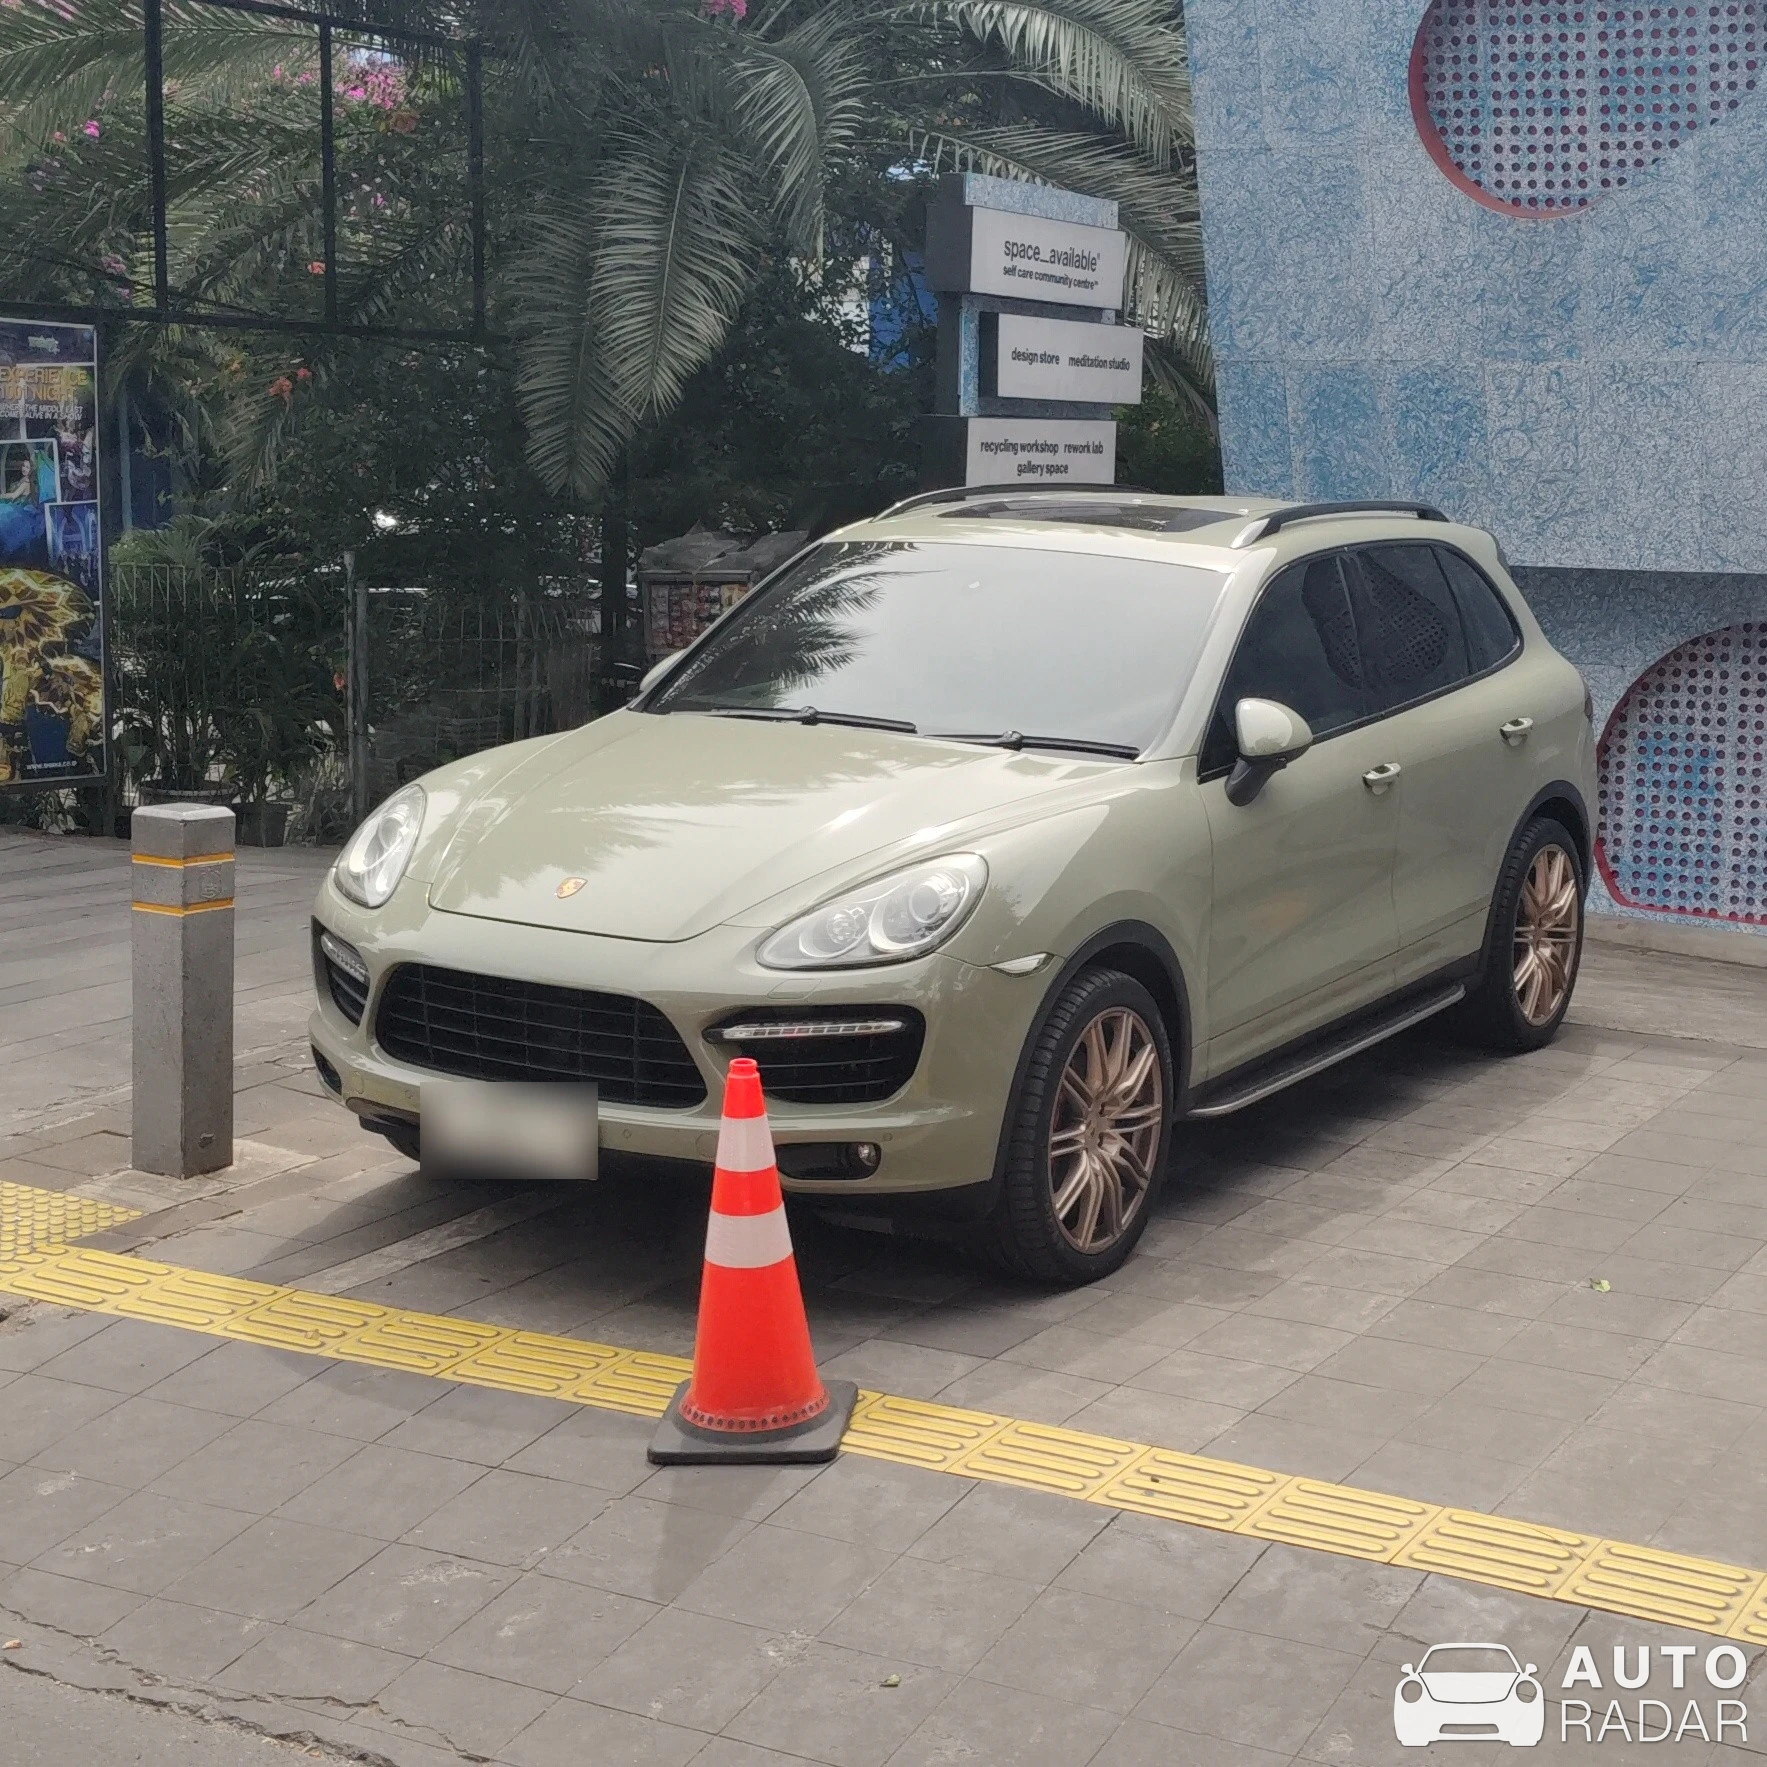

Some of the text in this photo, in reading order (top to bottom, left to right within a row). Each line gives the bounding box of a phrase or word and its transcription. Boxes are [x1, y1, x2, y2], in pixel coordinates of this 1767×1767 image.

[1003, 265, 1017, 277] self
[1017, 269, 1034, 280] care
[1034, 272, 1073, 288] community
[1011, 346, 1130, 371] design store meditation studio
[980, 438, 1104, 455] recycling workshop rework lab
[1016, 460, 1069, 476] gallery space
